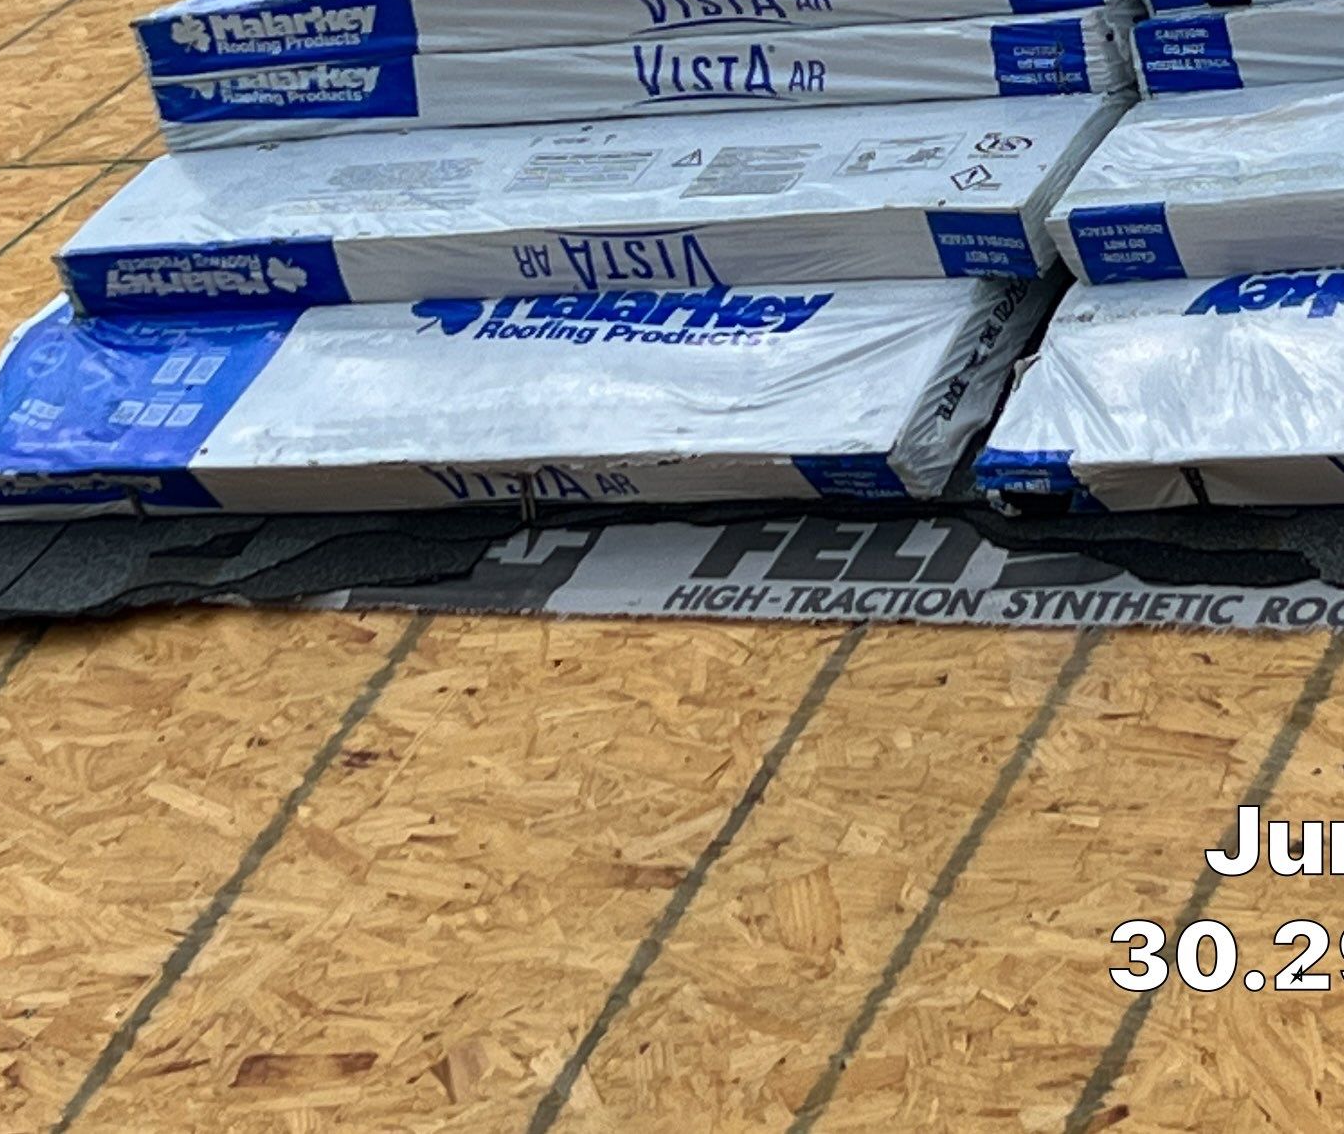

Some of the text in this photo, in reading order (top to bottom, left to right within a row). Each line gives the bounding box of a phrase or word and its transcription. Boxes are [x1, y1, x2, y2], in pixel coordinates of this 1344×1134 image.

[211, 3, 377, 41] Malarkey
[215, 31, 362, 56] Roofing Products
[221, 64, 381, 94] Malarkey
[633, 42, 827, 98] VISTA AR
[220, 86, 363, 106] Roofing Products
[512, 233, 726, 290] VISTA AR
[489, 284, 836, 334] Malarkey
[473, 319, 766, 349] Roofing Products
[594, 470, 641, 498] AR
[661, 582, 983, 617] HIGH-TRACTION
[1001, 588, 1244, 626] SYNTHETIC
